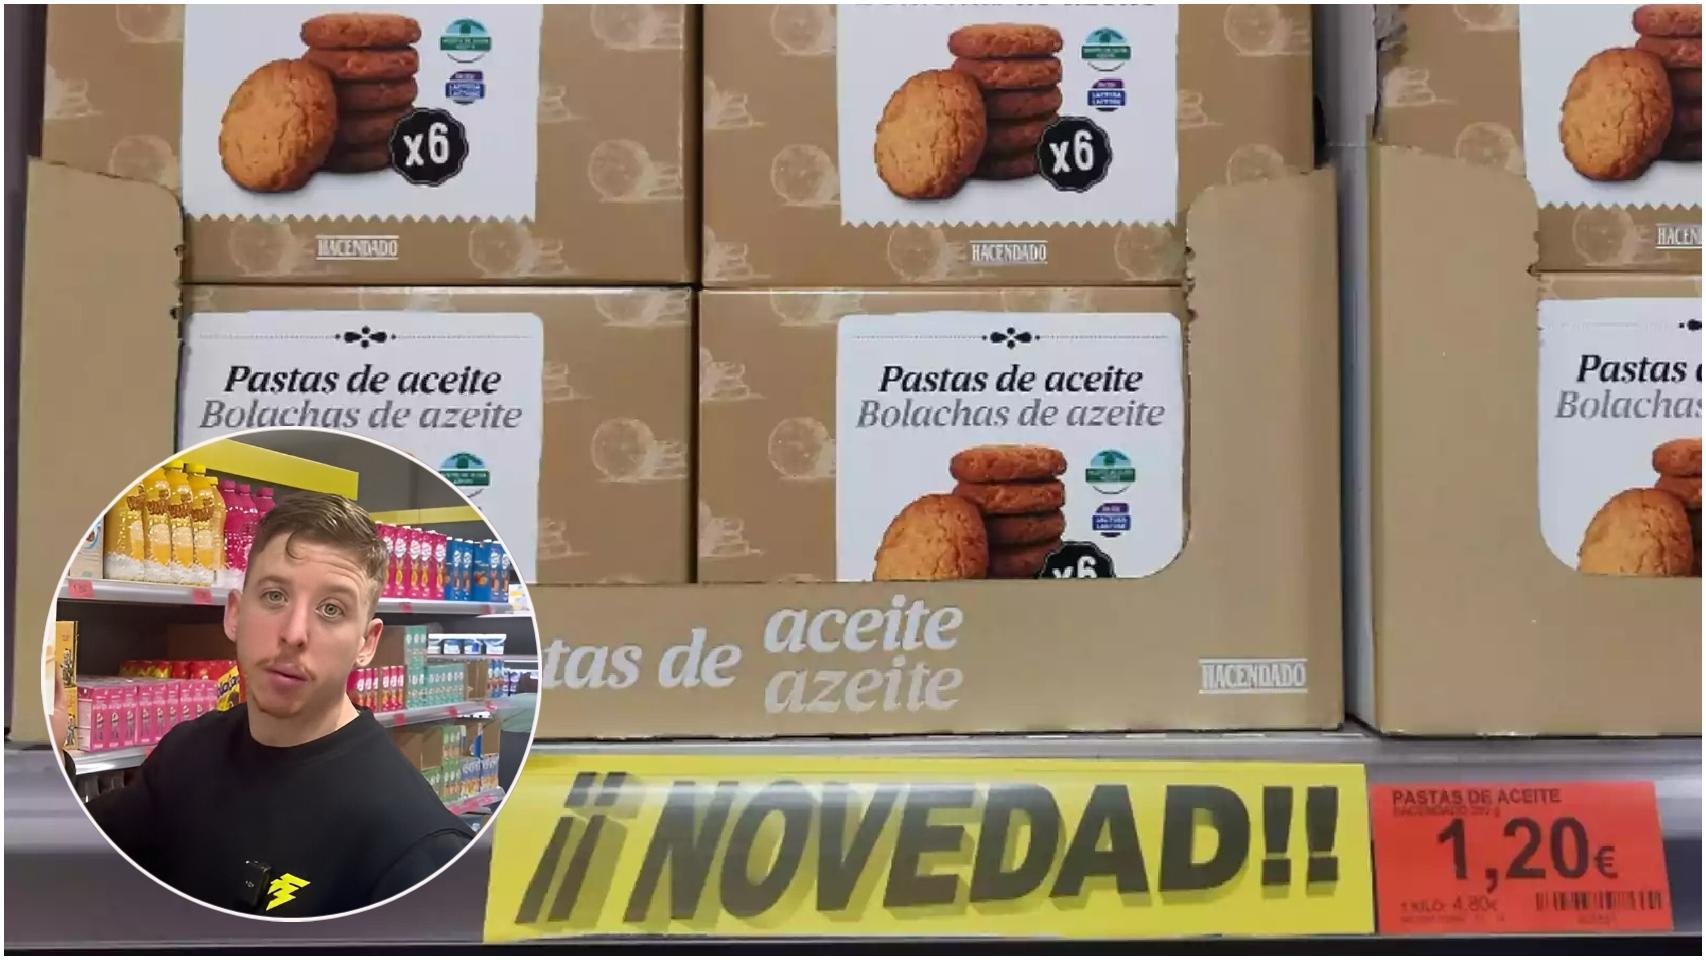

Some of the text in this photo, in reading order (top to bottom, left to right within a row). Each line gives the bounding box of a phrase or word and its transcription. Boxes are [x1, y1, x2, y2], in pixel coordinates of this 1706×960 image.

[403, 122, 449, 166] x6
[1049, 129, 1094, 174] x6
[317, 239, 398, 257] HACENDADO
[972, 244, 1046, 262] HACENDADO
[224, 363, 502, 394] Pastas de aceite
[878, 363, 1143, 393] Pastas de aceite
[1576, 354, 1687, 384] Pastas
[199, 400, 523, 429] Bolachas de azeite
[855, 398, 1167, 428] Bolachas de azeite
[764, 594, 963, 653] aceite
[658, 626, 743, 689] de
[764, 654, 963, 714] azeite
[1202, 663, 1306, 688] HACENDADO
[1392, 787, 1563, 805] PASTAS DE ACEITE
[1437, 816, 1619, 893] 1,20€
